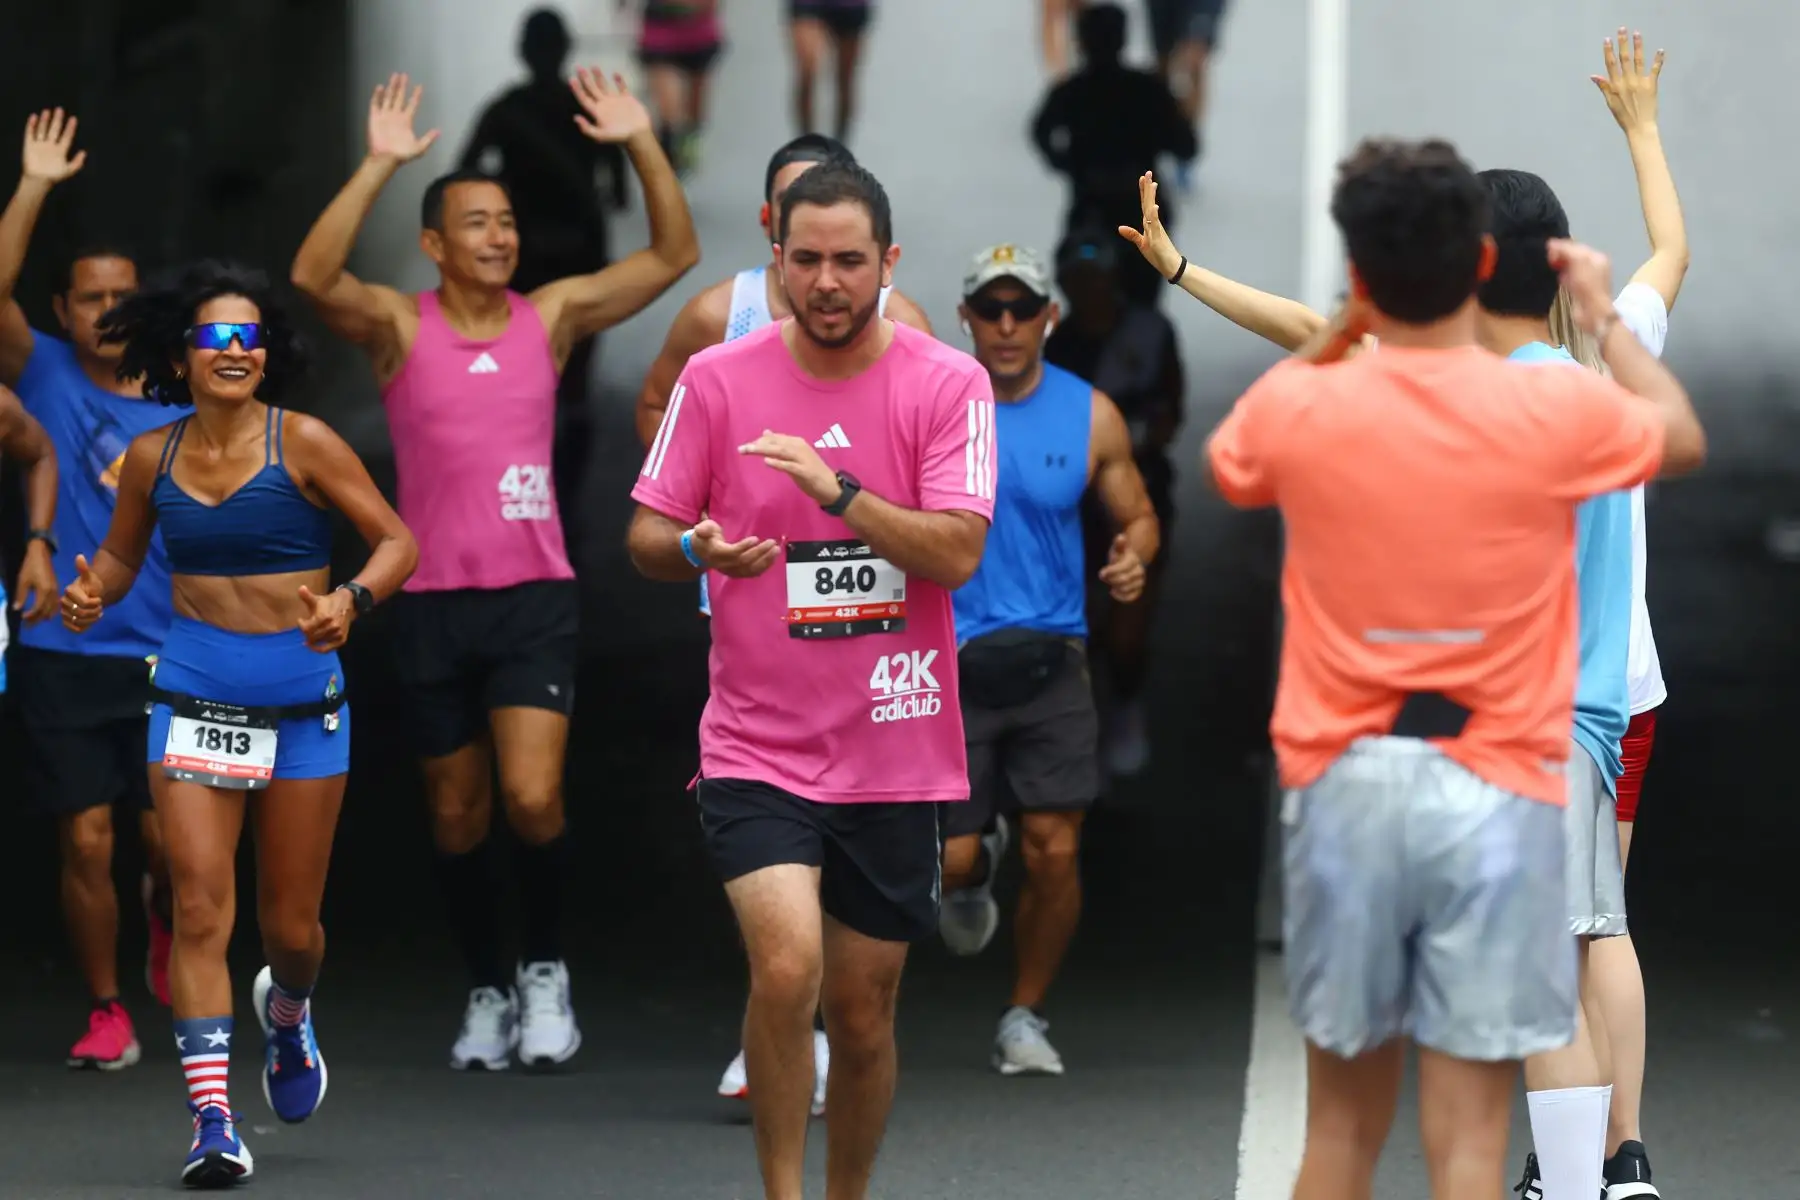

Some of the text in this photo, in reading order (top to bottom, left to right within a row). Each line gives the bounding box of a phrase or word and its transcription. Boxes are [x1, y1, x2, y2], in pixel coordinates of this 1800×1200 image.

[815, 565, 876, 595] 840
[835, 607, 859, 617] 42K
[869, 649, 940, 695] 42K
[871, 693, 941, 723] adiclub
[194, 726, 251, 755] 1813
